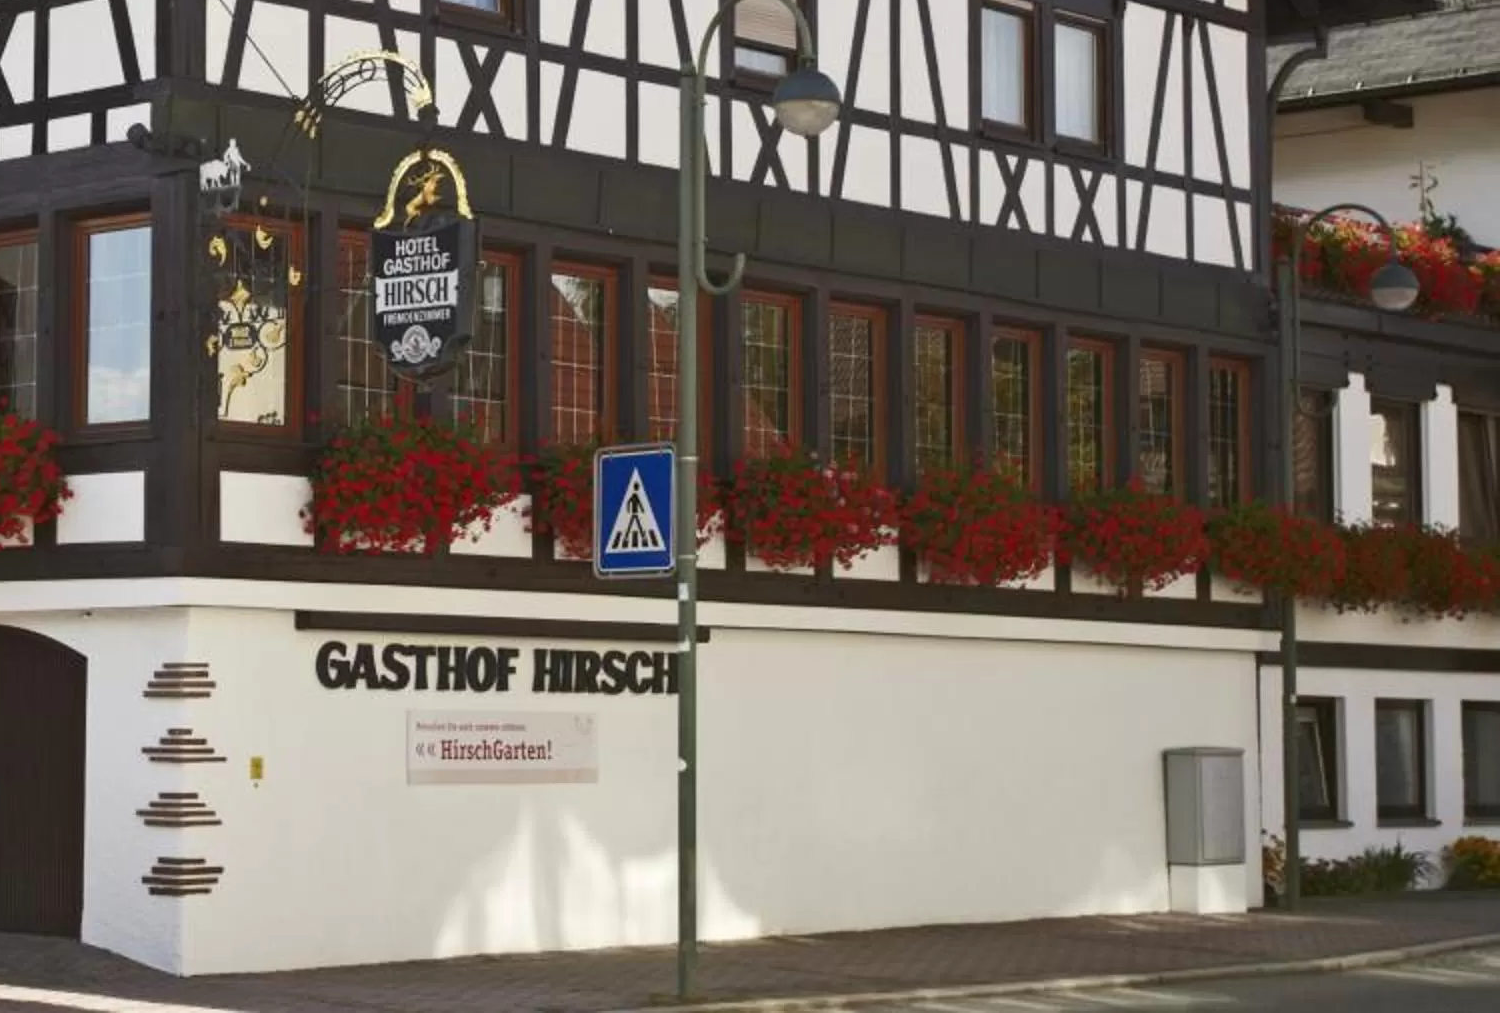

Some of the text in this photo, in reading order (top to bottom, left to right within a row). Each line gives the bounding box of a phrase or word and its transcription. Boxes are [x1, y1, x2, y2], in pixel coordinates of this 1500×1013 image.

[395, 237, 439, 256] HOTEL
[383, 252, 450, 276] GASTHOF
[384, 276, 449, 306] HIRSCH
[315, 641, 679, 695] GASTHOF HIRSCH
[440, 738, 553, 761] HirschGarten!
